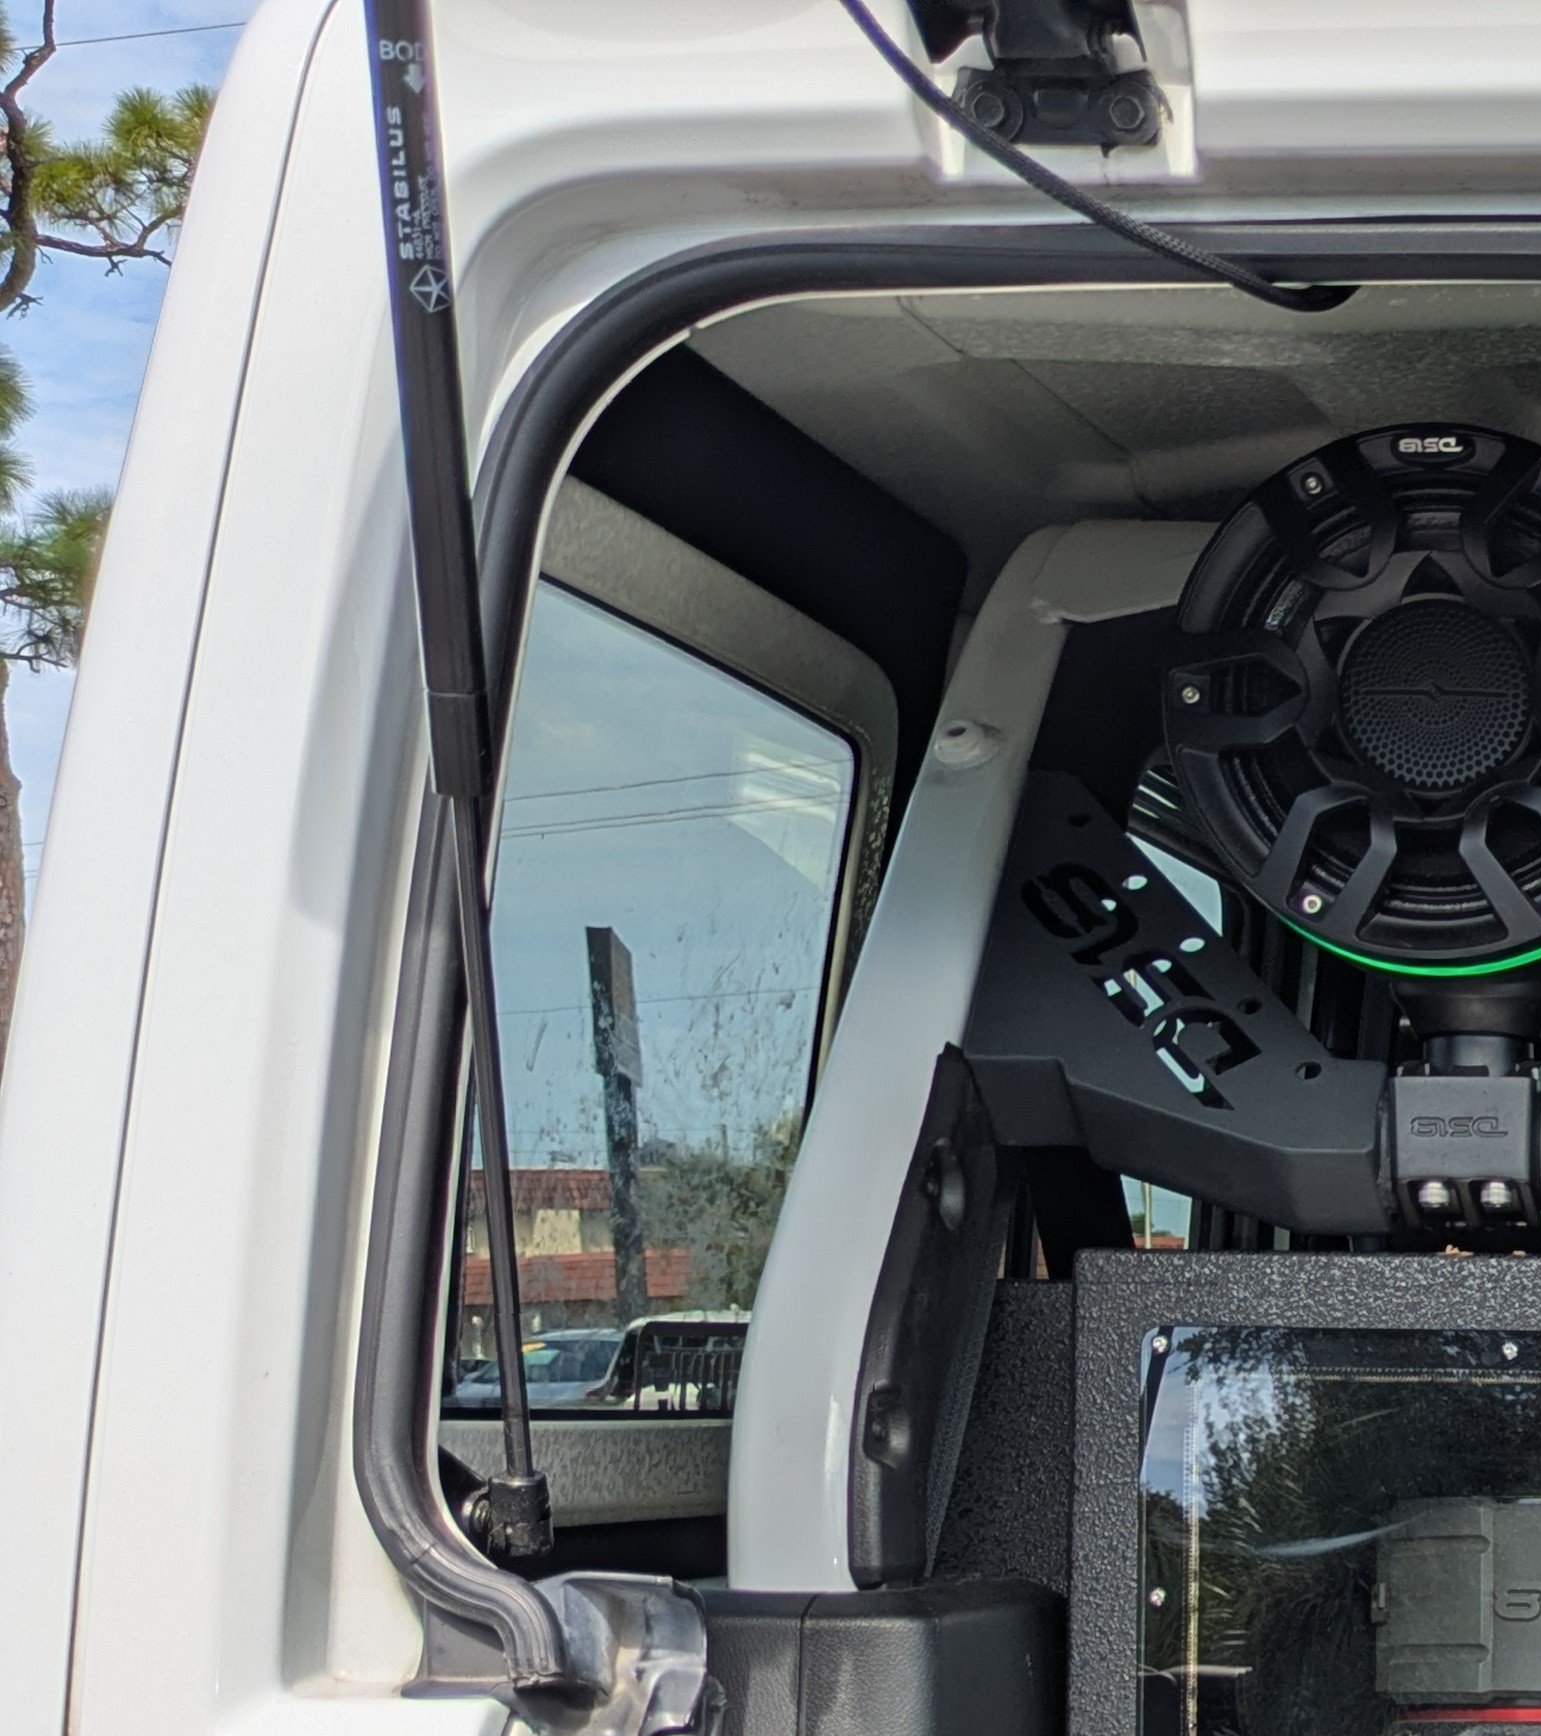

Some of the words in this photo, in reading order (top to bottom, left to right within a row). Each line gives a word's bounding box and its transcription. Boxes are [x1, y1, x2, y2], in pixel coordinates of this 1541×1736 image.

[386, 105, 414, 260] STABILUS
[1398, 436, 1464, 453] DS18
[1410, 1115, 1508, 1138] DS18
